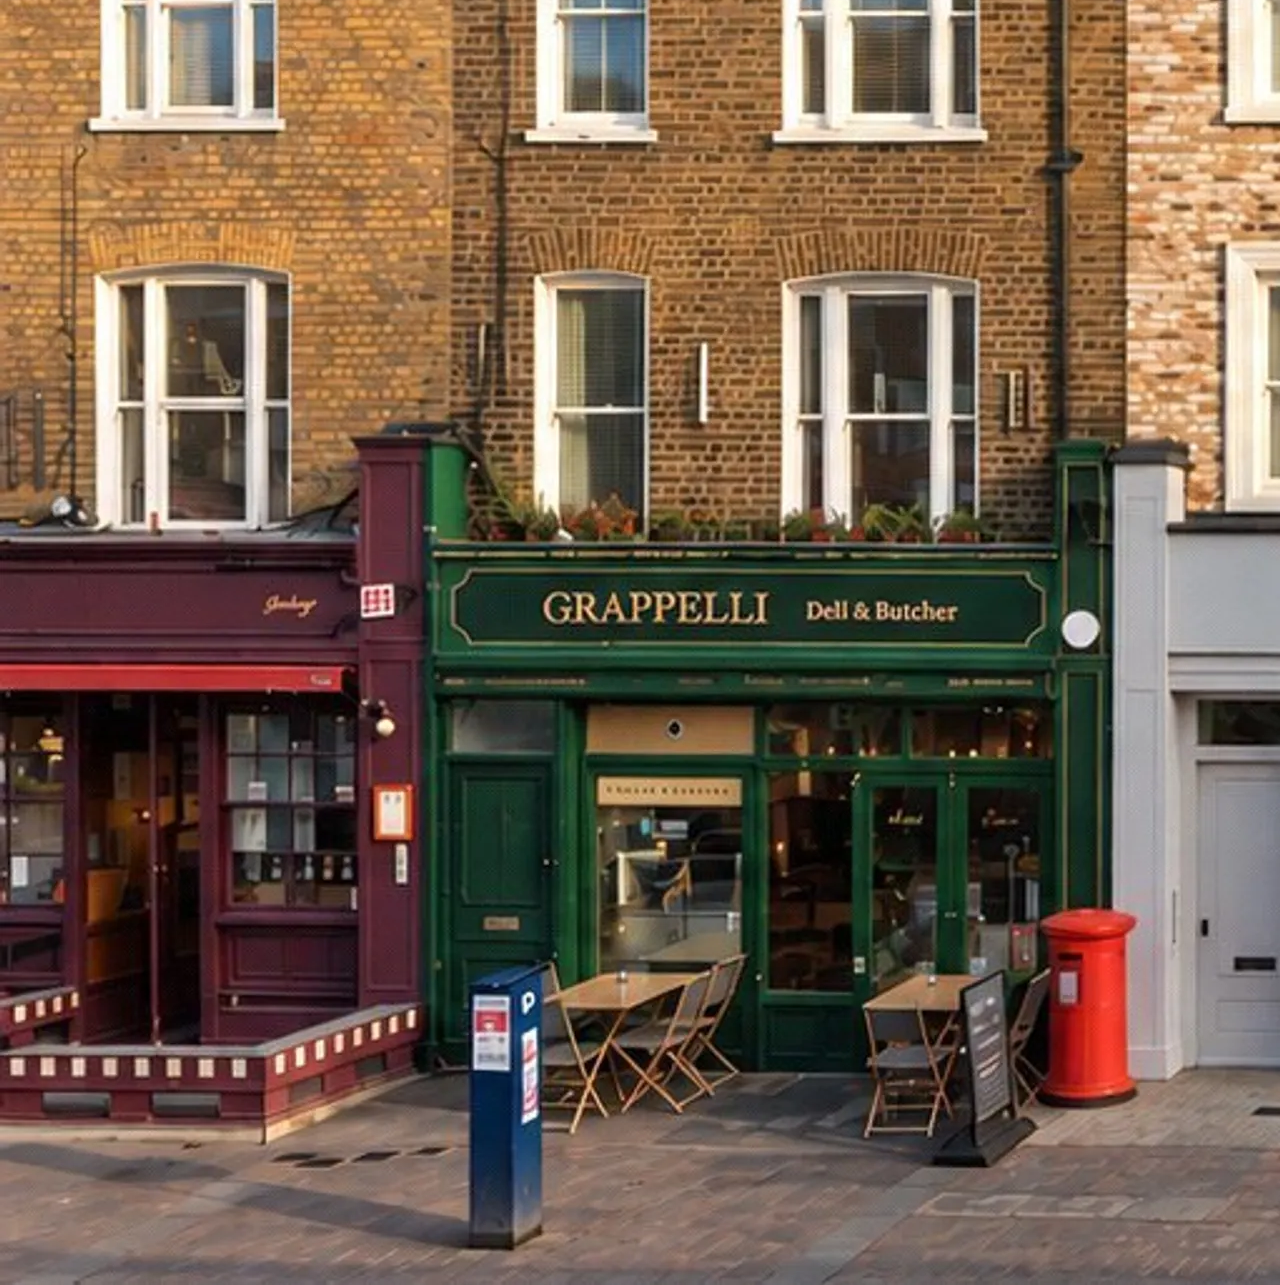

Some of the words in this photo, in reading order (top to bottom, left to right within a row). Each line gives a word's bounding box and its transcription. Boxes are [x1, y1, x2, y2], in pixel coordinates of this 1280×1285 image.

[543, 591, 769, 625] GRAPPELLI
[853, 601, 871, 621] &
[875, 600, 959, 622] Butcher
